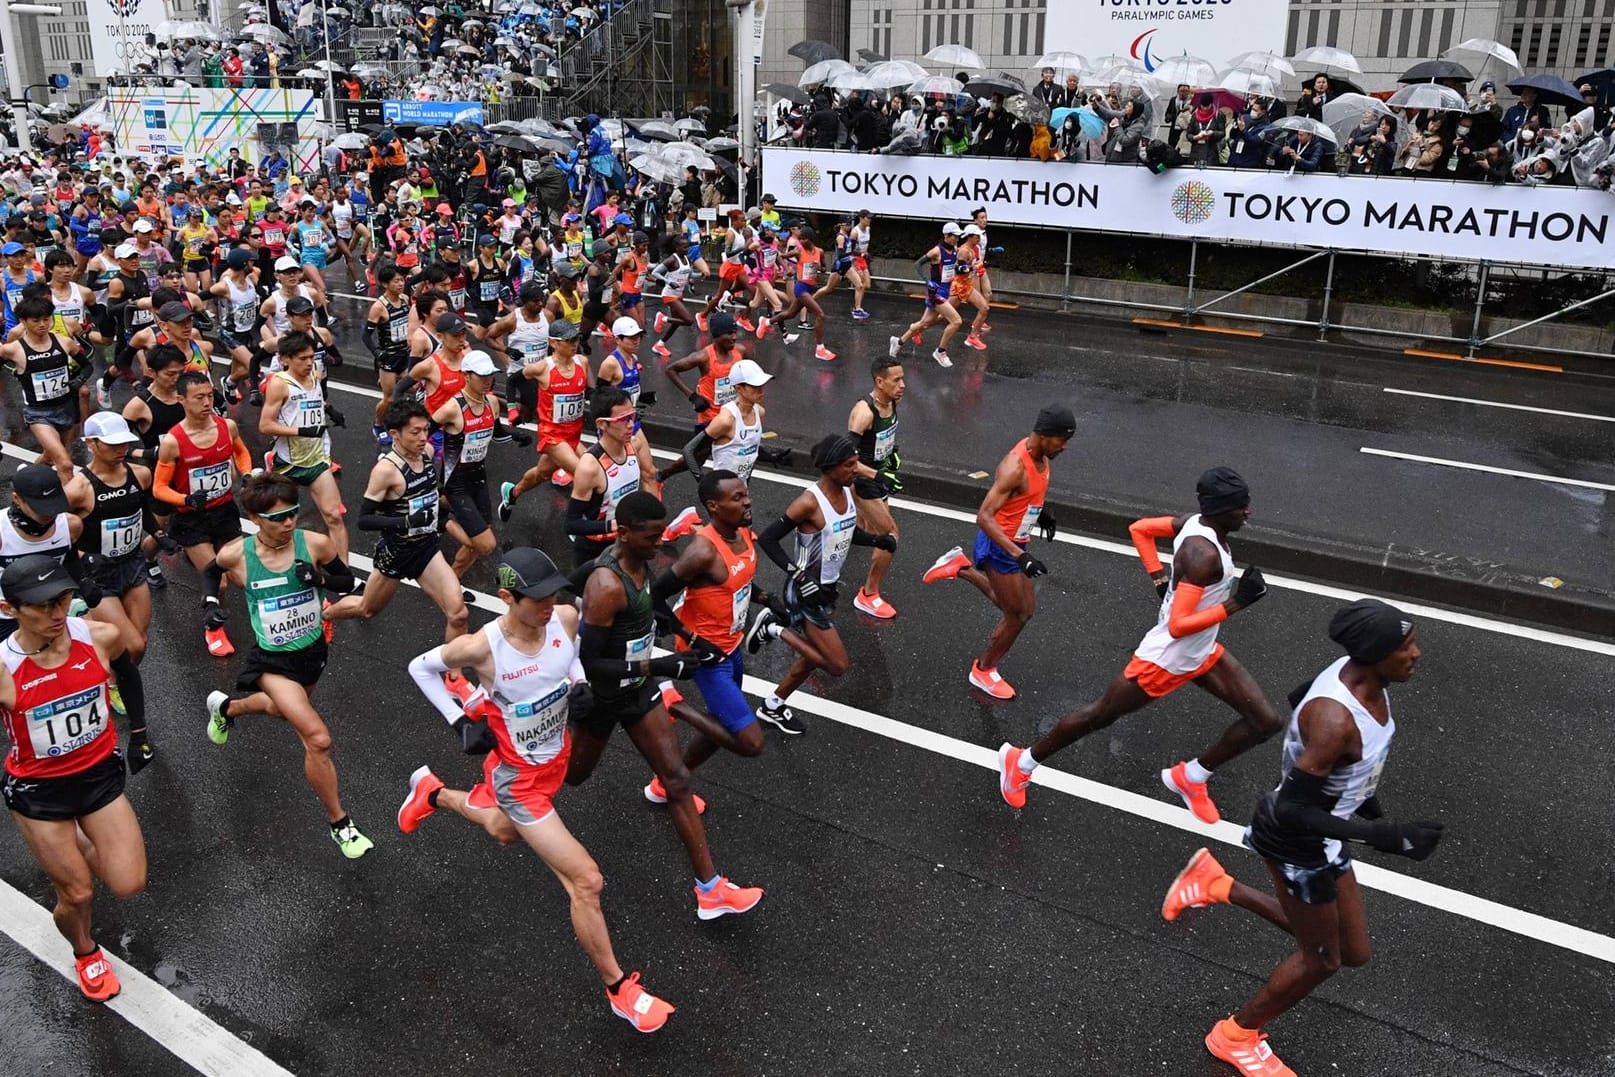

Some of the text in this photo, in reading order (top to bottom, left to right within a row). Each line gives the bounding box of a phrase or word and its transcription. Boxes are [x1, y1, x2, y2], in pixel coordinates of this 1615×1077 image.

[1111, 9, 1214, 20] PARALYMPIC GAMES
[105, 24, 131, 37] TOKO
[826, 170, 1099, 209] TOKYO MARATHON
[1223, 192, 1609, 244] TOKYO MARATHON
[28, 352, 51, 361] GMO
[42, 376, 69, 393] 126
[303, 409, 322, 425] 109
[561, 401, 582, 417] 108
[199, 471, 228, 491] 120
[97, 489, 127, 501] GMO
[113, 523, 141, 549] 102
[287, 608, 298, 619] 28
[269, 612, 316, 634] KAMINO
[502, 664, 539, 681] FUJITSU
[541, 707, 552, 721] 23
[46, 702, 102, 745] 104
